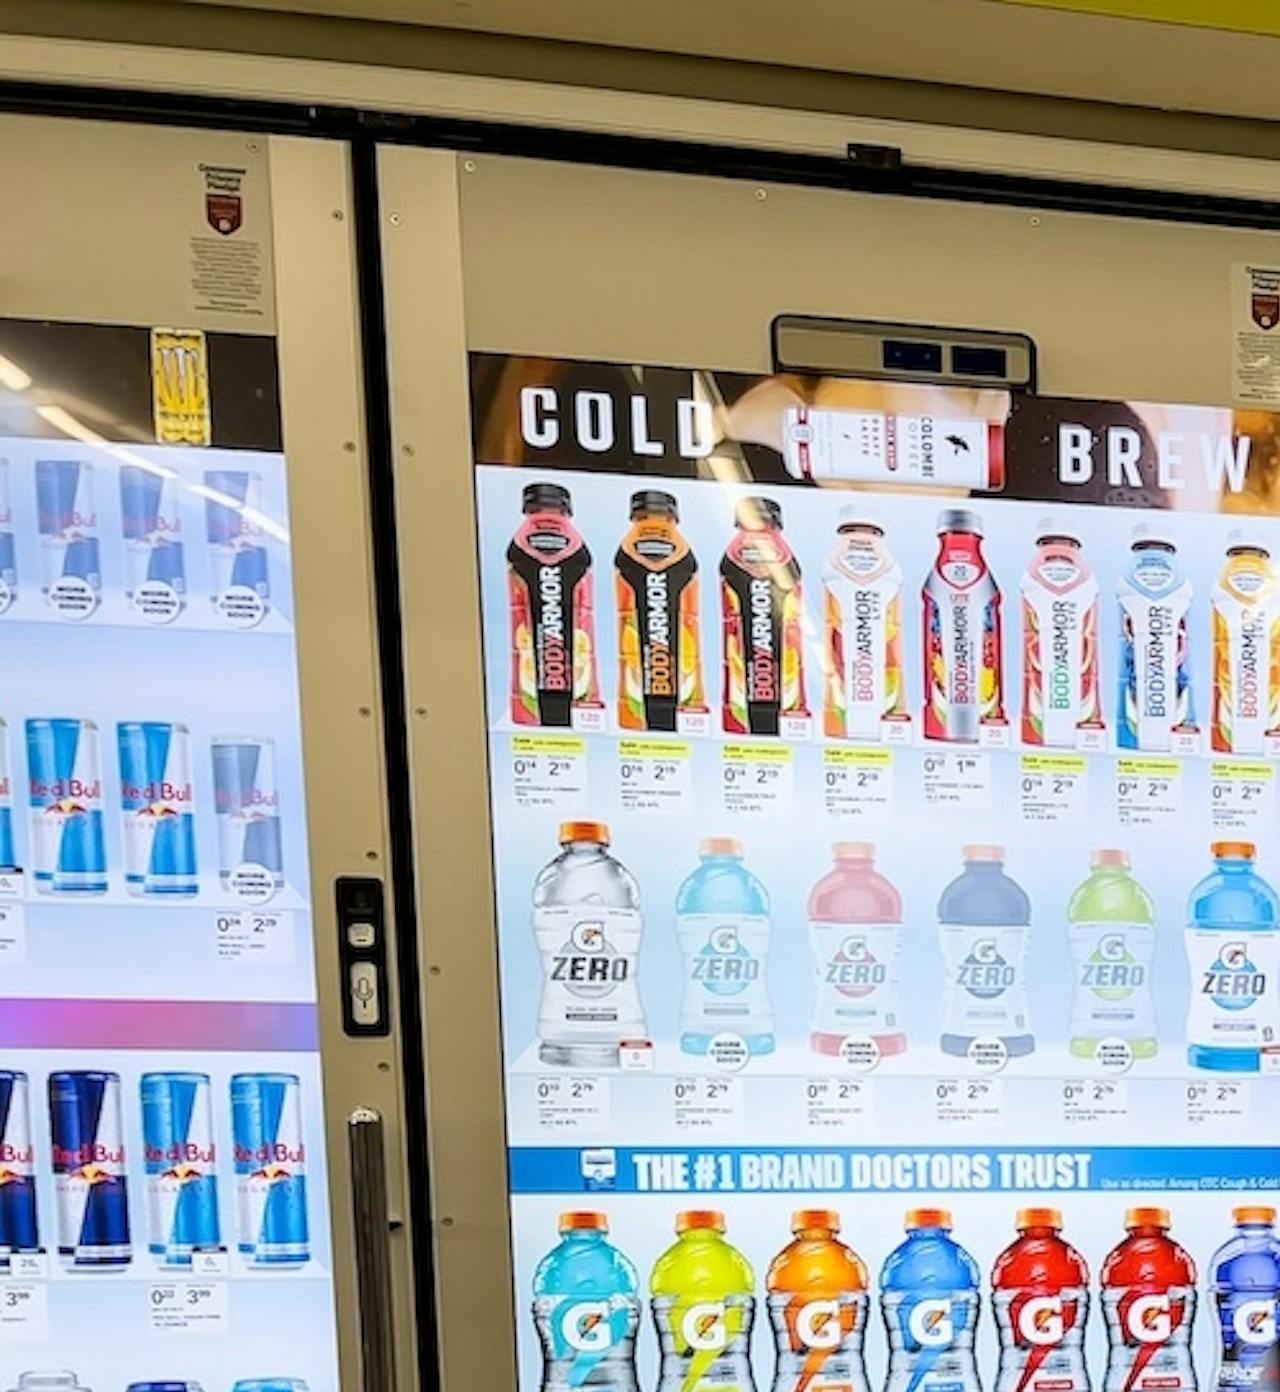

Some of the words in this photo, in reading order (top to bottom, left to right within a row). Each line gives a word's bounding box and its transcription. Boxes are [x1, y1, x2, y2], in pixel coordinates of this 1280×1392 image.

[521, 387, 716, 459] COLD
[1057, 422, 1253, 492] BREW
[544, 566, 562, 691] BODYARMOR
[648, 573, 667, 696] BODYARMOR
[753, 580, 770, 701] BODYARMOR
[857, 589, 873, 702] BODYARMOR
[954, 605, 969, 704] BODYARMOR
[1054, 600, 1069, 709] BODYARMOR
[1150, 606, 1166, 718] BODYARMOR
[1243, 604, 1258, 719] BODYARMOR
[551, 956, 628, 983] ZERO
[690, 958, 759, 981] ZERO
[825, 963, 885, 984] ZERO
[956, 966, 1014, 987] ZERO
[1081, 965, 1144, 987] ZERO
[1203, 973, 1265, 996] ZERO
[632, 1154, 690, 1190] THE
[694, 1155, 737, 1189] #1
[740, 1154, 845, 1190] BRAND
[851, 1154, 991, 1189] DOCTORS
[998, 1153, 1092, 1189] TRUST
